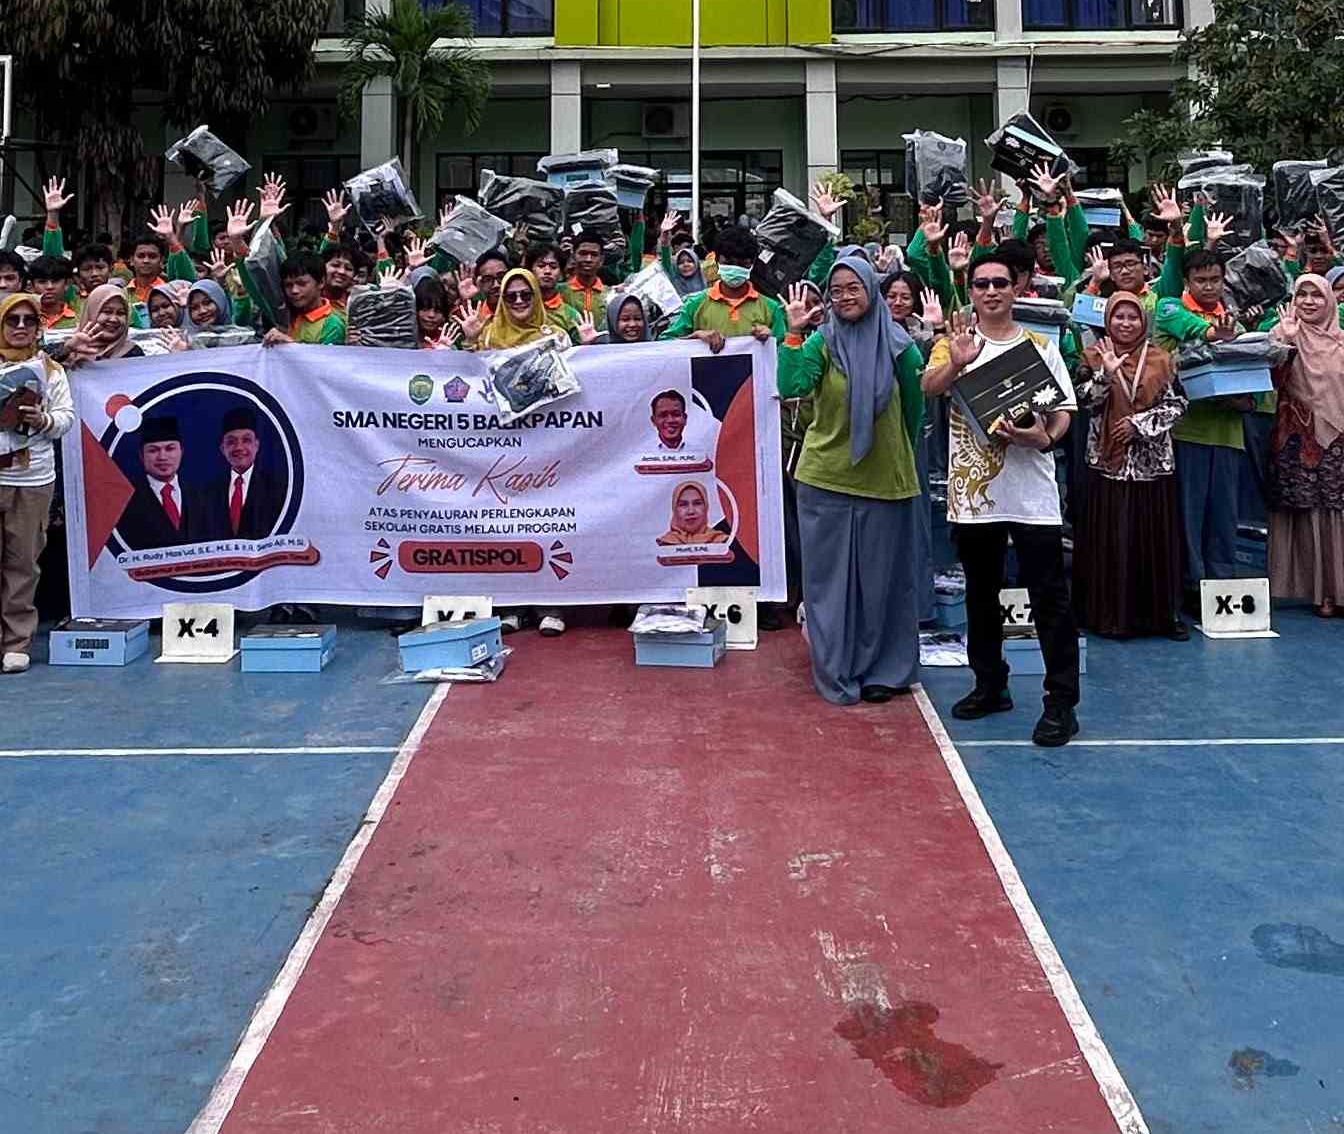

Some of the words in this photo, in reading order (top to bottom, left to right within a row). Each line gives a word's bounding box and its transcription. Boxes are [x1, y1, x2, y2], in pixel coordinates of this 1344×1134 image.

[332, 410, 380, 429] SMA
[383, 412, 453, 430] NEGERI
[457, 413, 469, 430] 5
[418, 437, 522, 449] MENGUCAPKAN
[376, 454, 467, 496] Terima
[472, 454, 561, 505] Kasih
[369, 507, 397, 517] ATAS
[400, 509, 477, 520] PENYALURAN
[481, 507, 575, 518] PERLENGKAPAN
[364, 521, 416, 533] SEKOLAH
[420, 523, 461, 534] GRATIS
[464, 523, 514, 534] MELALUI
[517, 522, 577, 533] PROGRAM
[413, 548, 527, 566] GRATISPOL
[1215, 594, 1256, 615] X-8
[177, 618, 220, 638] X-4
